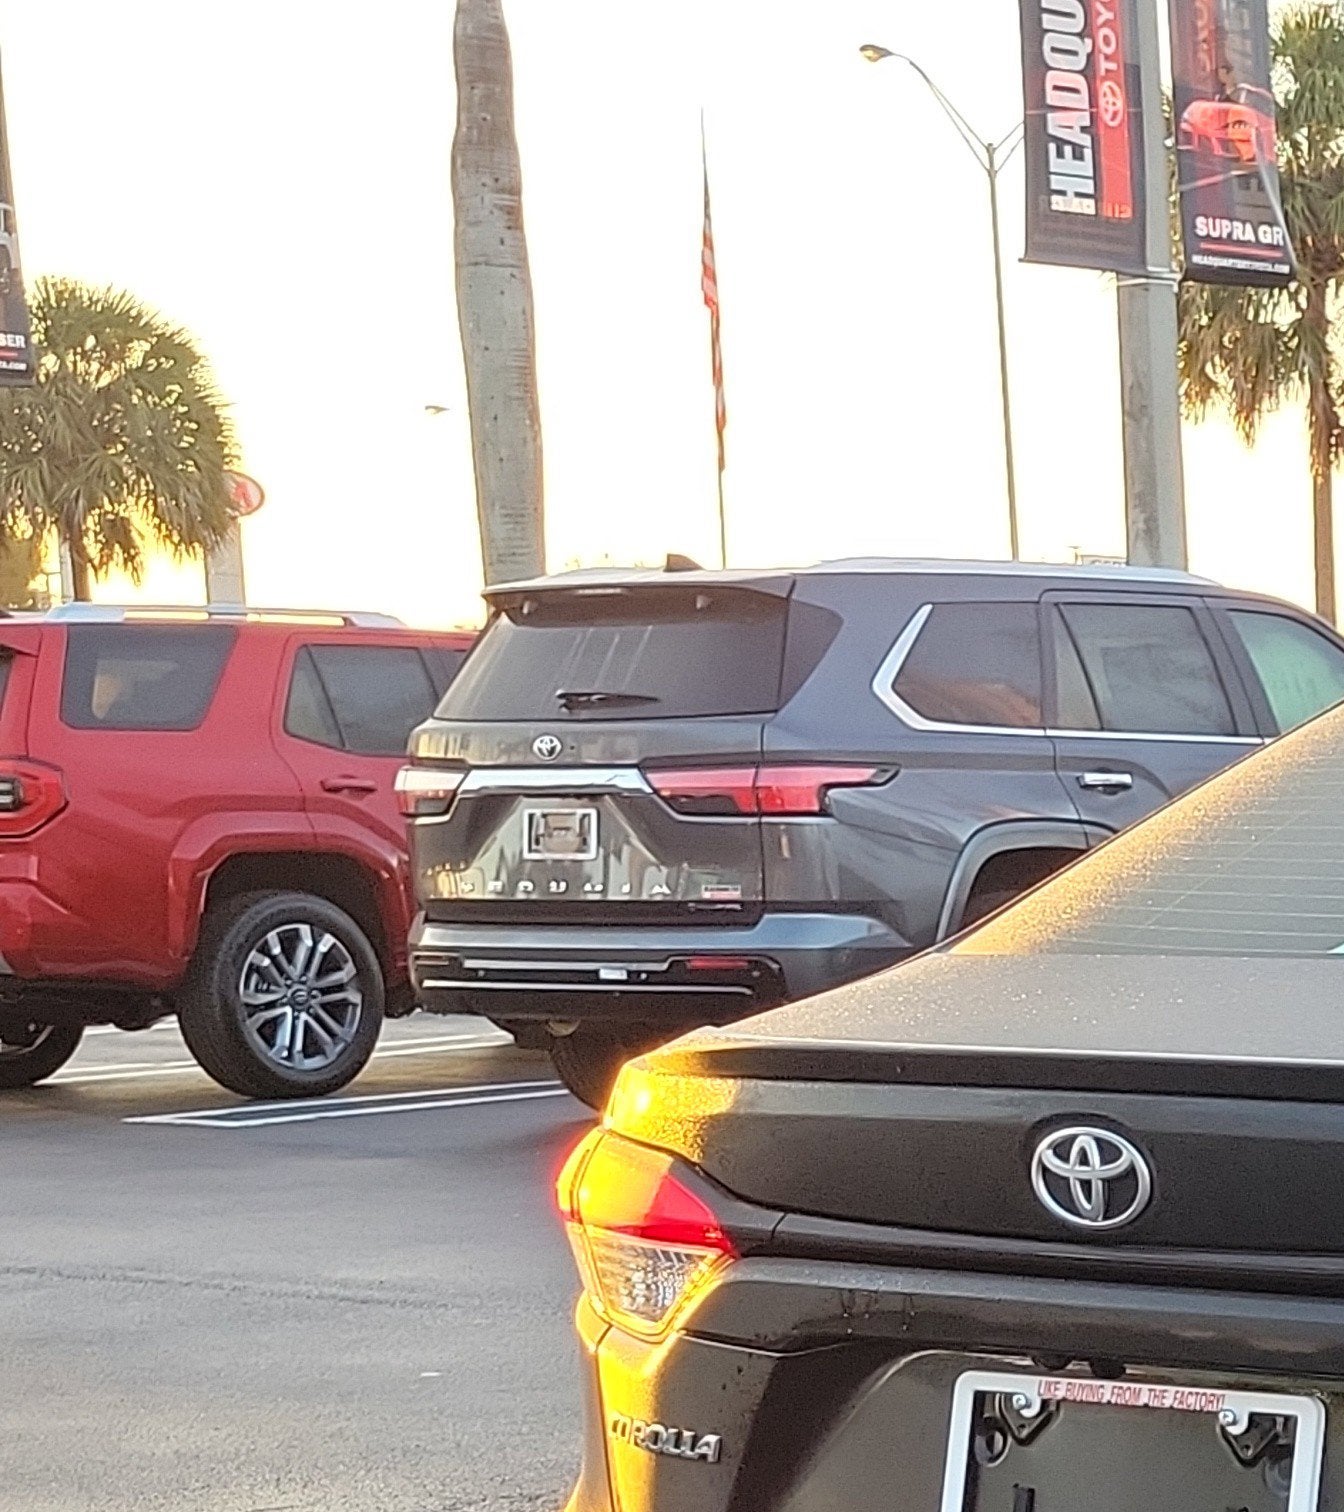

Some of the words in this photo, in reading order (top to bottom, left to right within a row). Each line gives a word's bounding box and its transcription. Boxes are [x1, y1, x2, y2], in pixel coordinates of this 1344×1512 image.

[1194, 216, 1256, 243] SUPRA
[1257, 224, 1284, 246] GR
[1038, 1379, 1061, 1398] LIKE
[1065, 1382, 1104, 1402] BUYING
[1111, 1385, 1143, 1405] FROM
[1148, 1388, 1168, 1407] THE
[1173, 1390, 1226, 1412] FACTORY!
